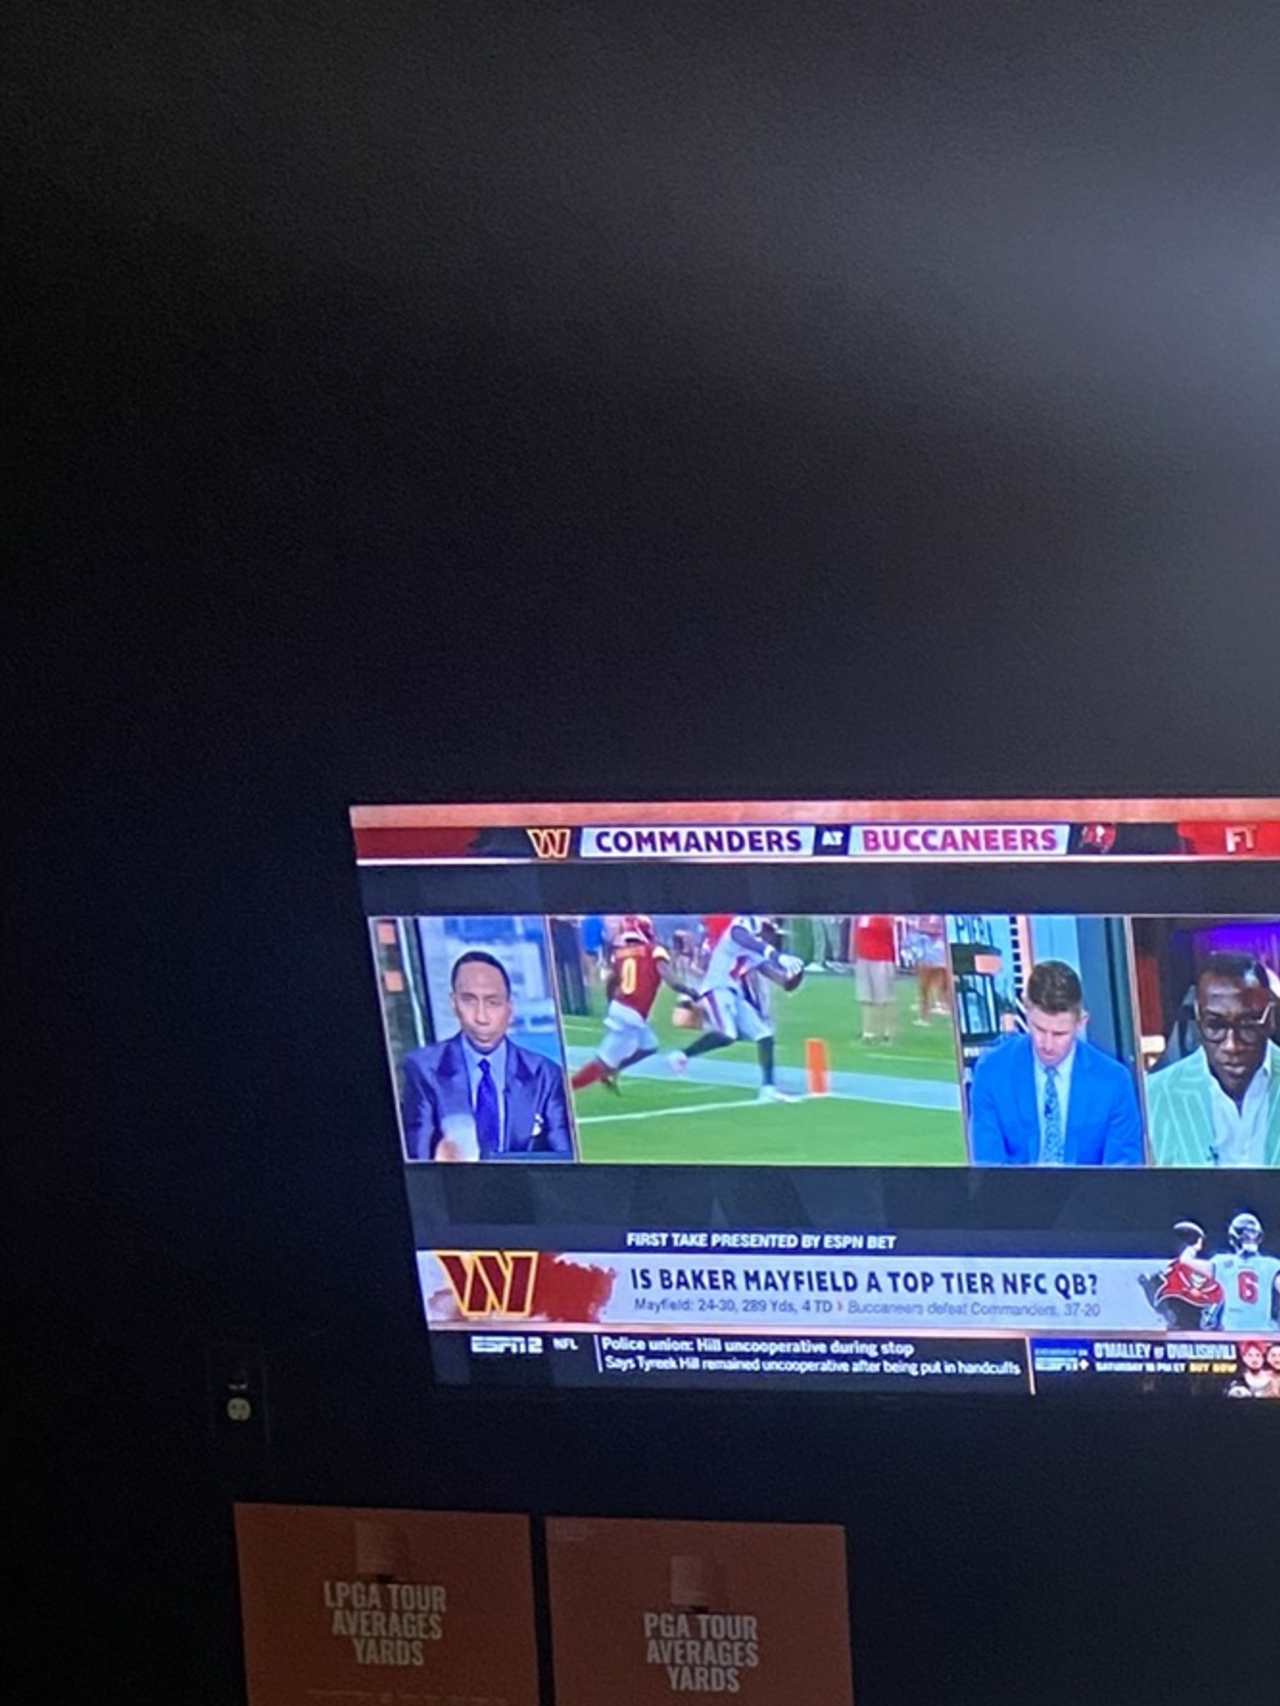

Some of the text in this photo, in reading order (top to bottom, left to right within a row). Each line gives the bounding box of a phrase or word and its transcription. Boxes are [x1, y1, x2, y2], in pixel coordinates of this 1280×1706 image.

[595, 829, 802, 853] COMMANDERS
[862, 828, 1057, 852] BUCCANEERS
[1226, 827, 1257, 854] FT
[626, 1232, 896, 1250] FIRST TAKE PRESENTED BY ESPN BET
[631, 1268, 1098, 1299] IS BAKER MAYFIELD A TOP TIER NFC QB?
[1237, 1270, 1260, 1305] 6
[634, 1298, 695, 1314] Mayfield:
[698, 1299, 738, 1315] 24-30,
[742, 1300, 767, 1313] 289
[769, 1300, 798, 1315] Yds,
[801, 1300, 811, 1313] 4
[813, 1301, 833, 1314] TD
[848, 1301, 923, 1315] Buccaneers
[927, 1301, 968, 1316] defeat
[1063, 1303, 1100, 1317] 37-20
[553, 1337, 579, 1351] NFL
[602, 1336, 914, 1358] Police union: Hill uncooperative during stop
[605, 1356, 1021, 1376] Says Tyreek Hill remained uncooperative after being put in handcuffs
[324, 1580, 447, 1614] LPGA TOUR
[332, 1609, 443, 1641] AVERAGES
[644, 1612, 759, 1642] PGA TOUR
[353, 1637, 425, 1667] YARDS
[647, 1639, 759, 1669] AVERAGES
[667, 1666, 740, 1693] YARDS
